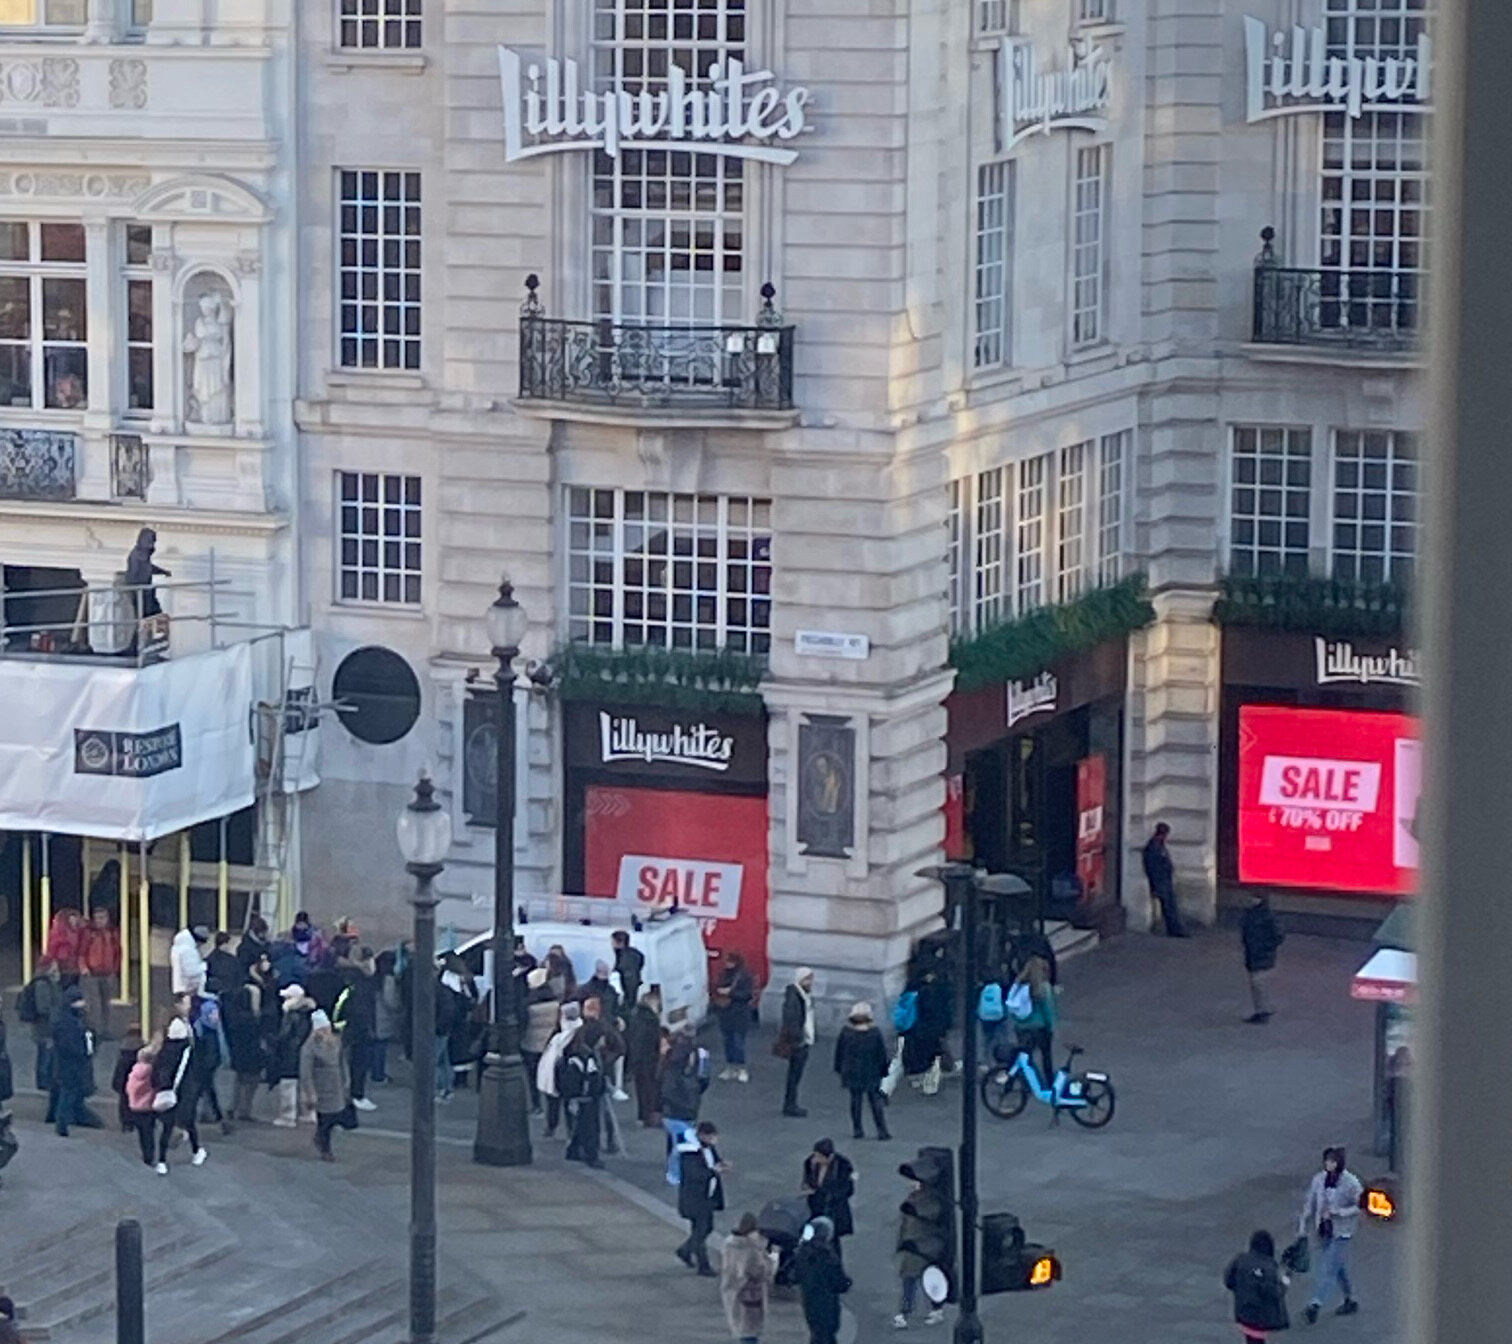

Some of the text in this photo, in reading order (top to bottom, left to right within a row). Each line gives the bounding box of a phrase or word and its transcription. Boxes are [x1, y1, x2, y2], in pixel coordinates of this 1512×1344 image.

[497, 43, 810, 163] Lillywhites
[599, 710, 735, 771] Lillywhites
[1279, 765, 1361, 803] SALE
[1279, 807, 1323, 831] 70%
[1325, 809, 1364, 832] OFF
[637, 865, 722, 907] SALE
